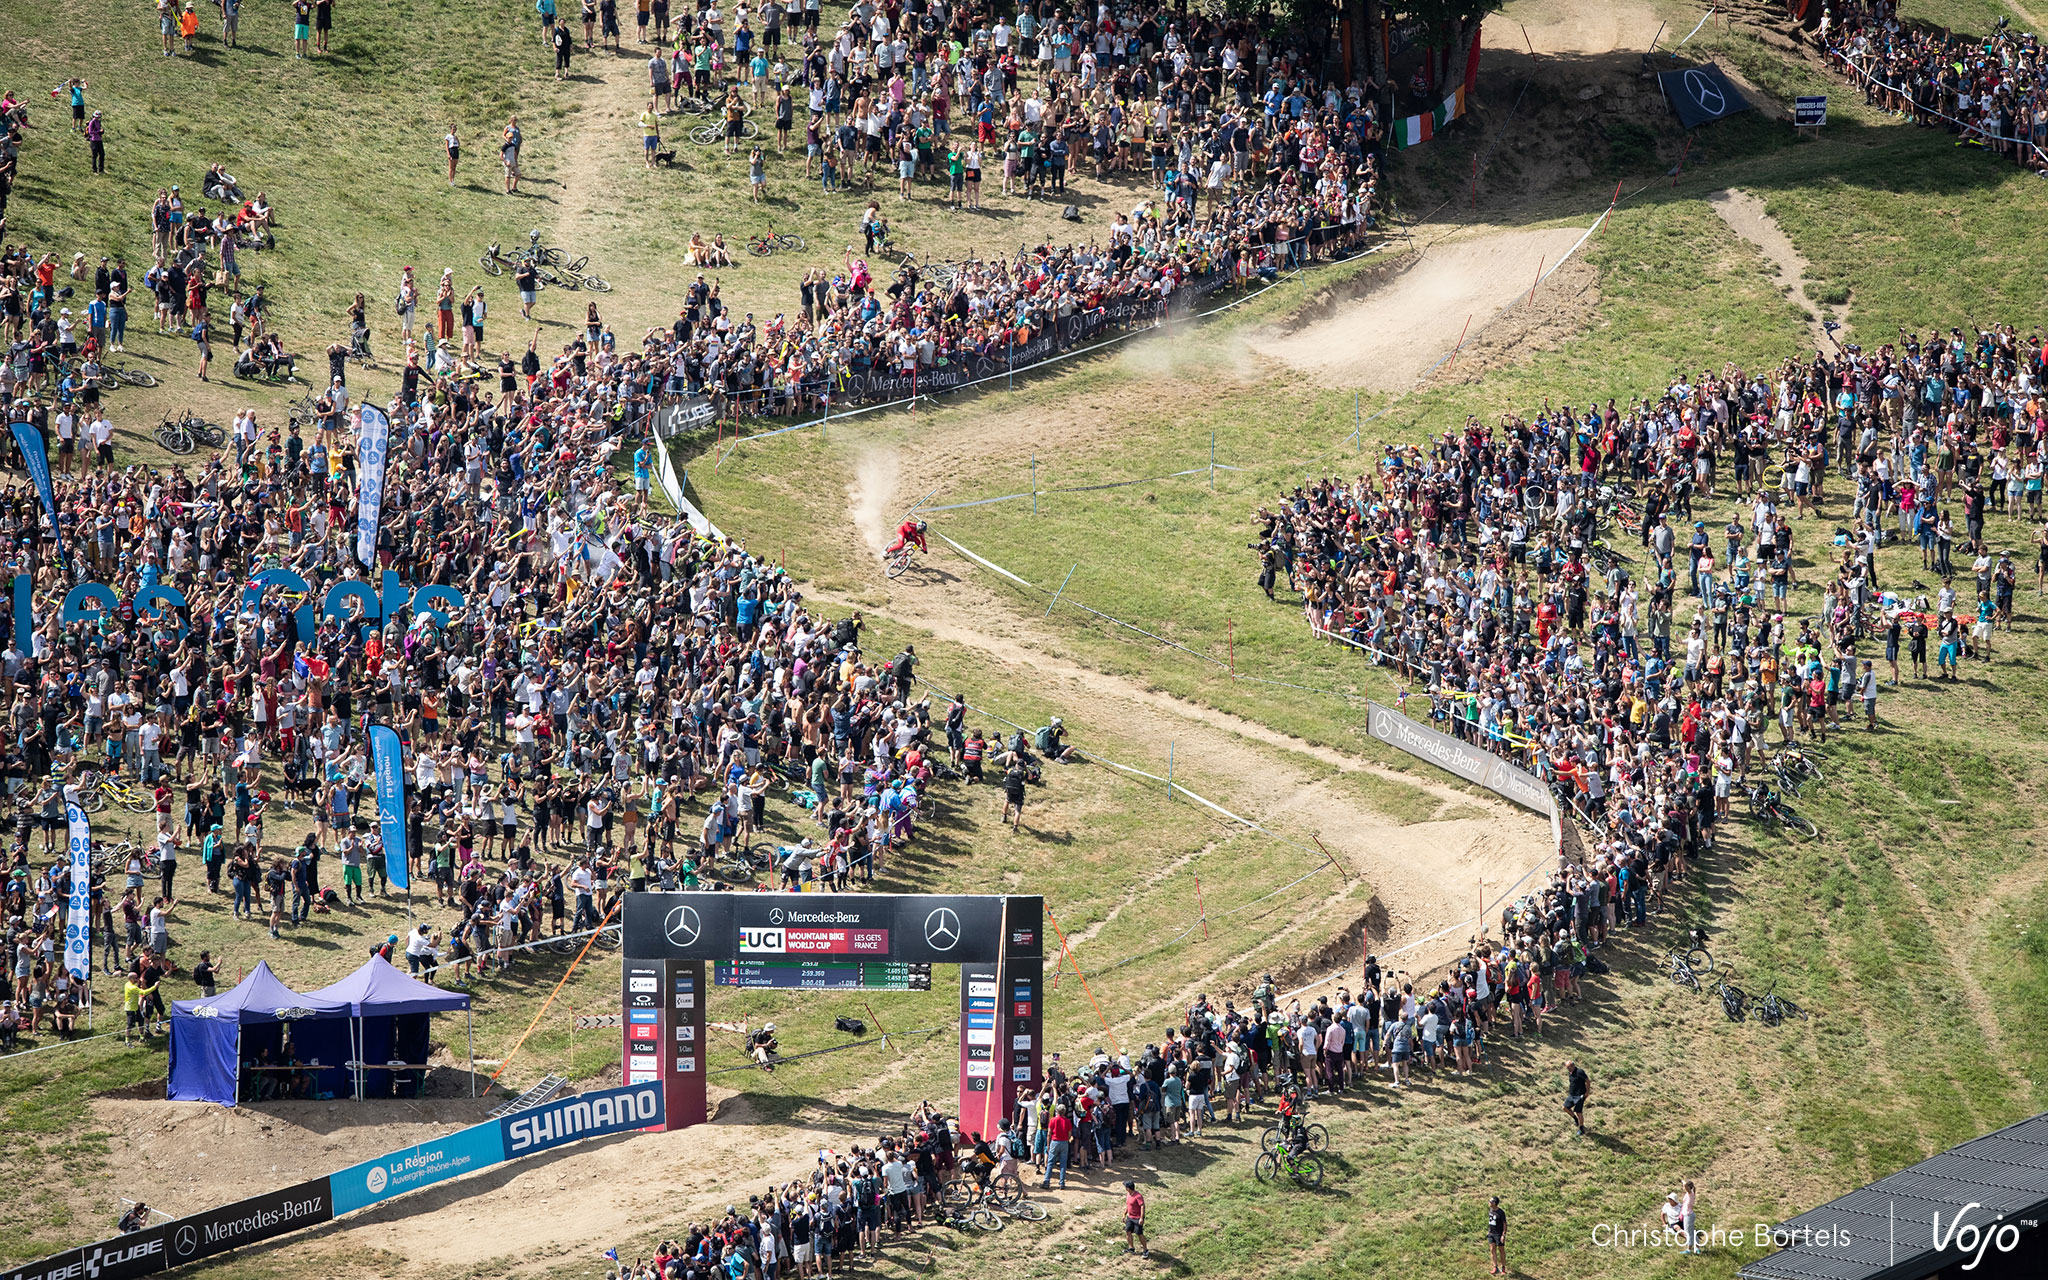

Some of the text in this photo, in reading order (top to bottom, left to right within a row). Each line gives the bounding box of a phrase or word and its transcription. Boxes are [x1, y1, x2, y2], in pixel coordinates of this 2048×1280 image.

[678, 403, 714, 424] CUBE
[1396, 722, 1481, 774] Mercedes-Benz
[788, 911, 860, 923] Mercedes-Benz
[748, 932, 782, 948] UCI
[788, 932, 845, 941] MOUNTAIN BIKE
[509, 1090, 657, 1151] SHIMANO
[390, 1150, 443, 1174] La Région
[392, 1155, 471, 1186] Auvergne-Rhône-Alpes
[204, 1196, 322, 1244] Mercedes-Benz
[103, 1238, 164, 1268] CUBE
